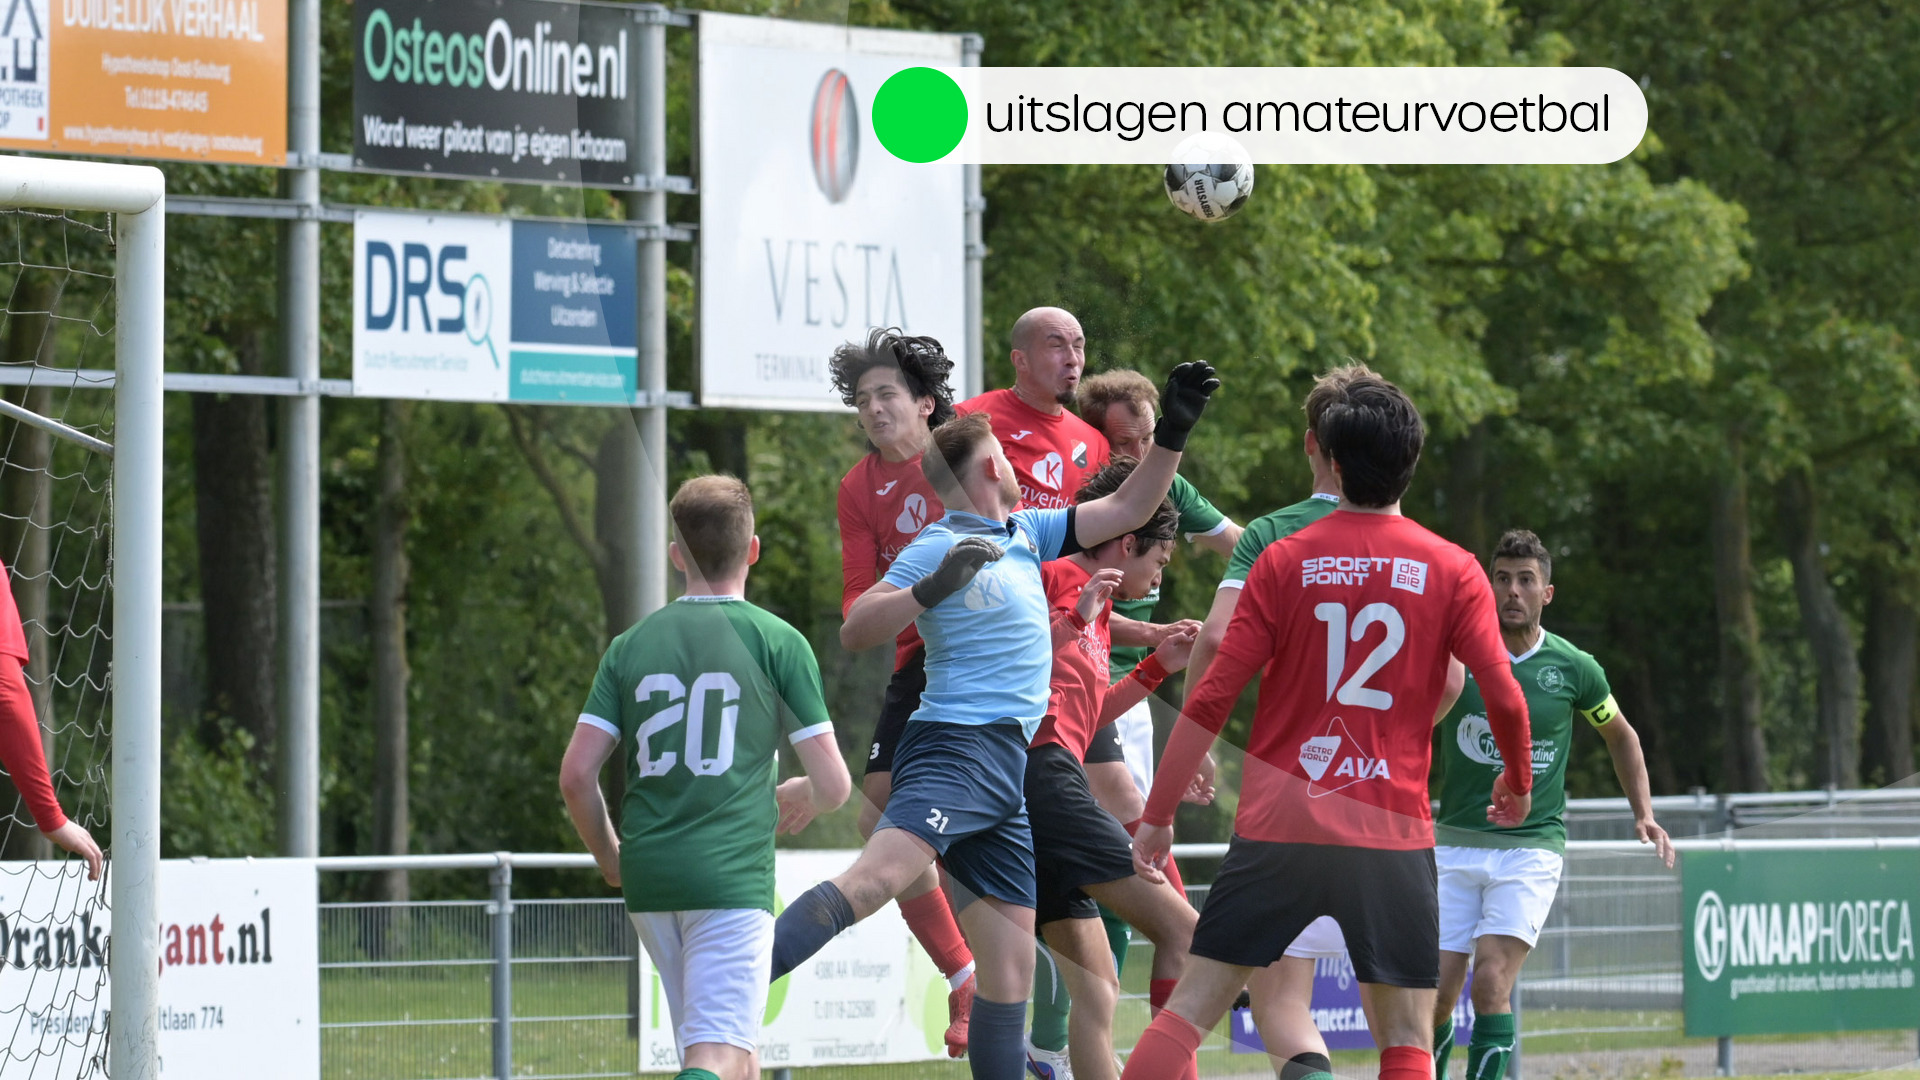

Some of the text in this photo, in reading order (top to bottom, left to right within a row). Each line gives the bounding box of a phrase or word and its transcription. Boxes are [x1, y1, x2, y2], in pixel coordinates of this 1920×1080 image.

[63, 0, 265, 42] DUIDELIJK VERHAAL
[363, 8, 627, 100] OsteosOnline.nl
[0, 87, 44, 109] OTHEEK
[363, 115, 627, 165] Word weer piloot van je eigen lichaam
[366, 240, 467, 333] DRS
[764, 237, 909, 330] VESTA
[755, 353, 825, 383] TERMINAL
[1302, 556, 1391, 574] SPORT
[1302, 572, 1369, 588] POINT
[1314, 602, 1406, 711] 12
[635, 672, 741, 778] 20
[1591, 704, 1611, 723] C
[870, 742, 880, 760] 3
[1333, 756, 1390, 780] AVA
[925, 808, 949, 834] 21
[1730, 899, 1915, 966] KNAAPHORECA
[30, 1008, 96, 1036] President
[201, 1006, 224, 1030] 774
